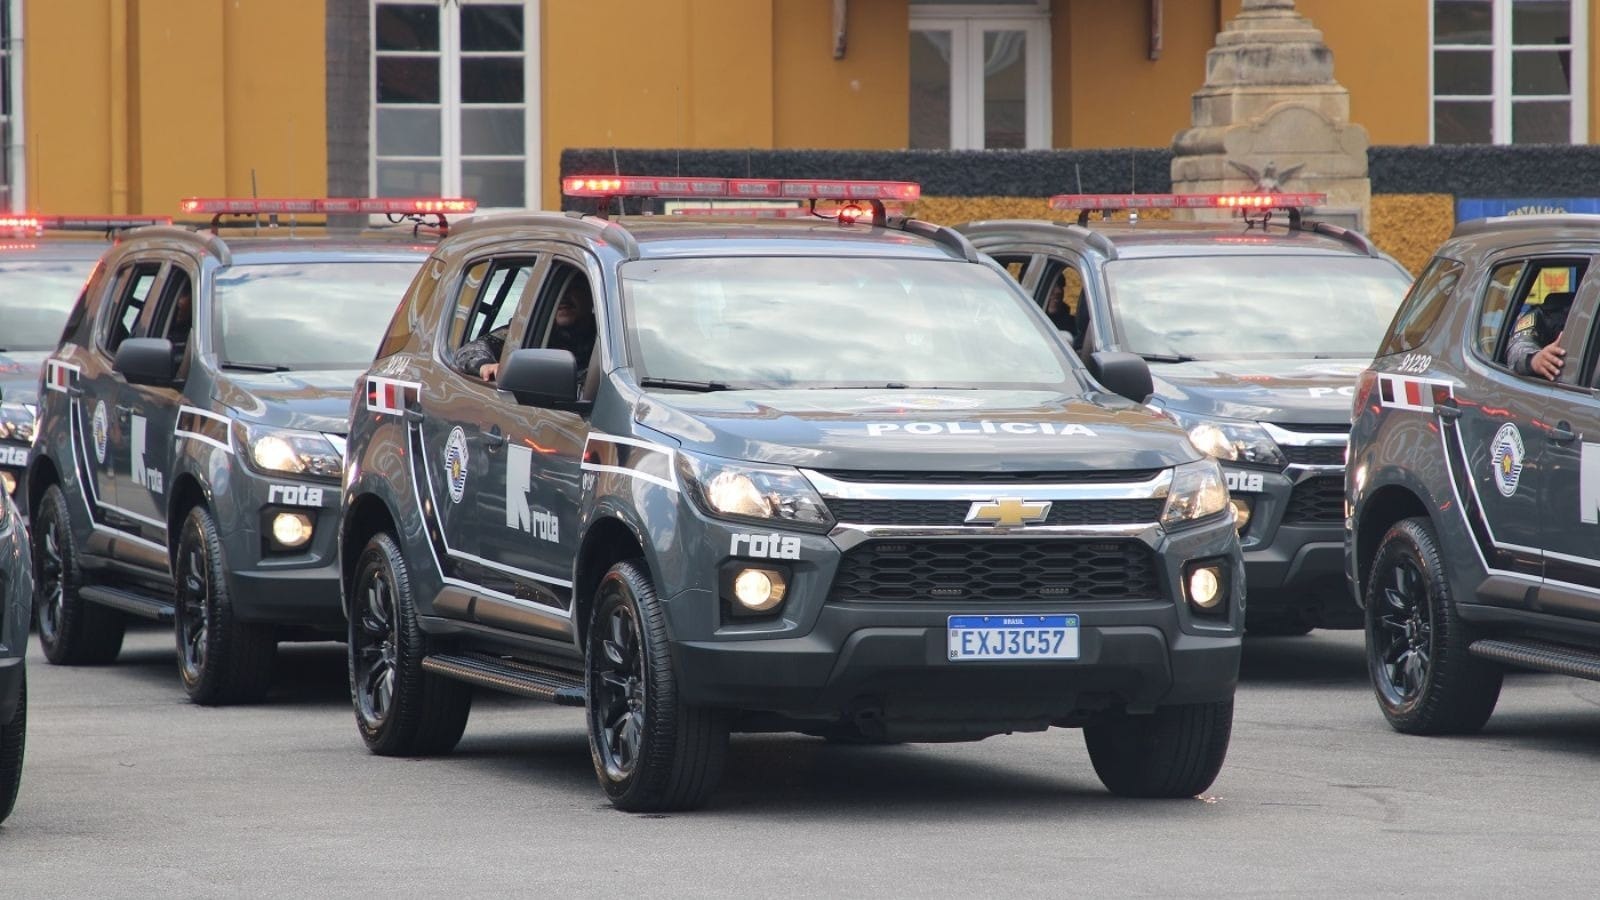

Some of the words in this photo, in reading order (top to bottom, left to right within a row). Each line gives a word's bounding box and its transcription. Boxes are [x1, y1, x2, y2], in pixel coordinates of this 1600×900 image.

[1308, 387, 1356, 398] PO
[866, 420, 1098, 437] POLÍCIA
[0, 446, 28, 466] ota
[1225, 471, 1264, 492] ota
[268, 485, 323, 507] rota
[533, 510, 560, 543] rota
[730, 533, 801, 560] rota
[962, 630, 1065, 655] EXJ3C57
